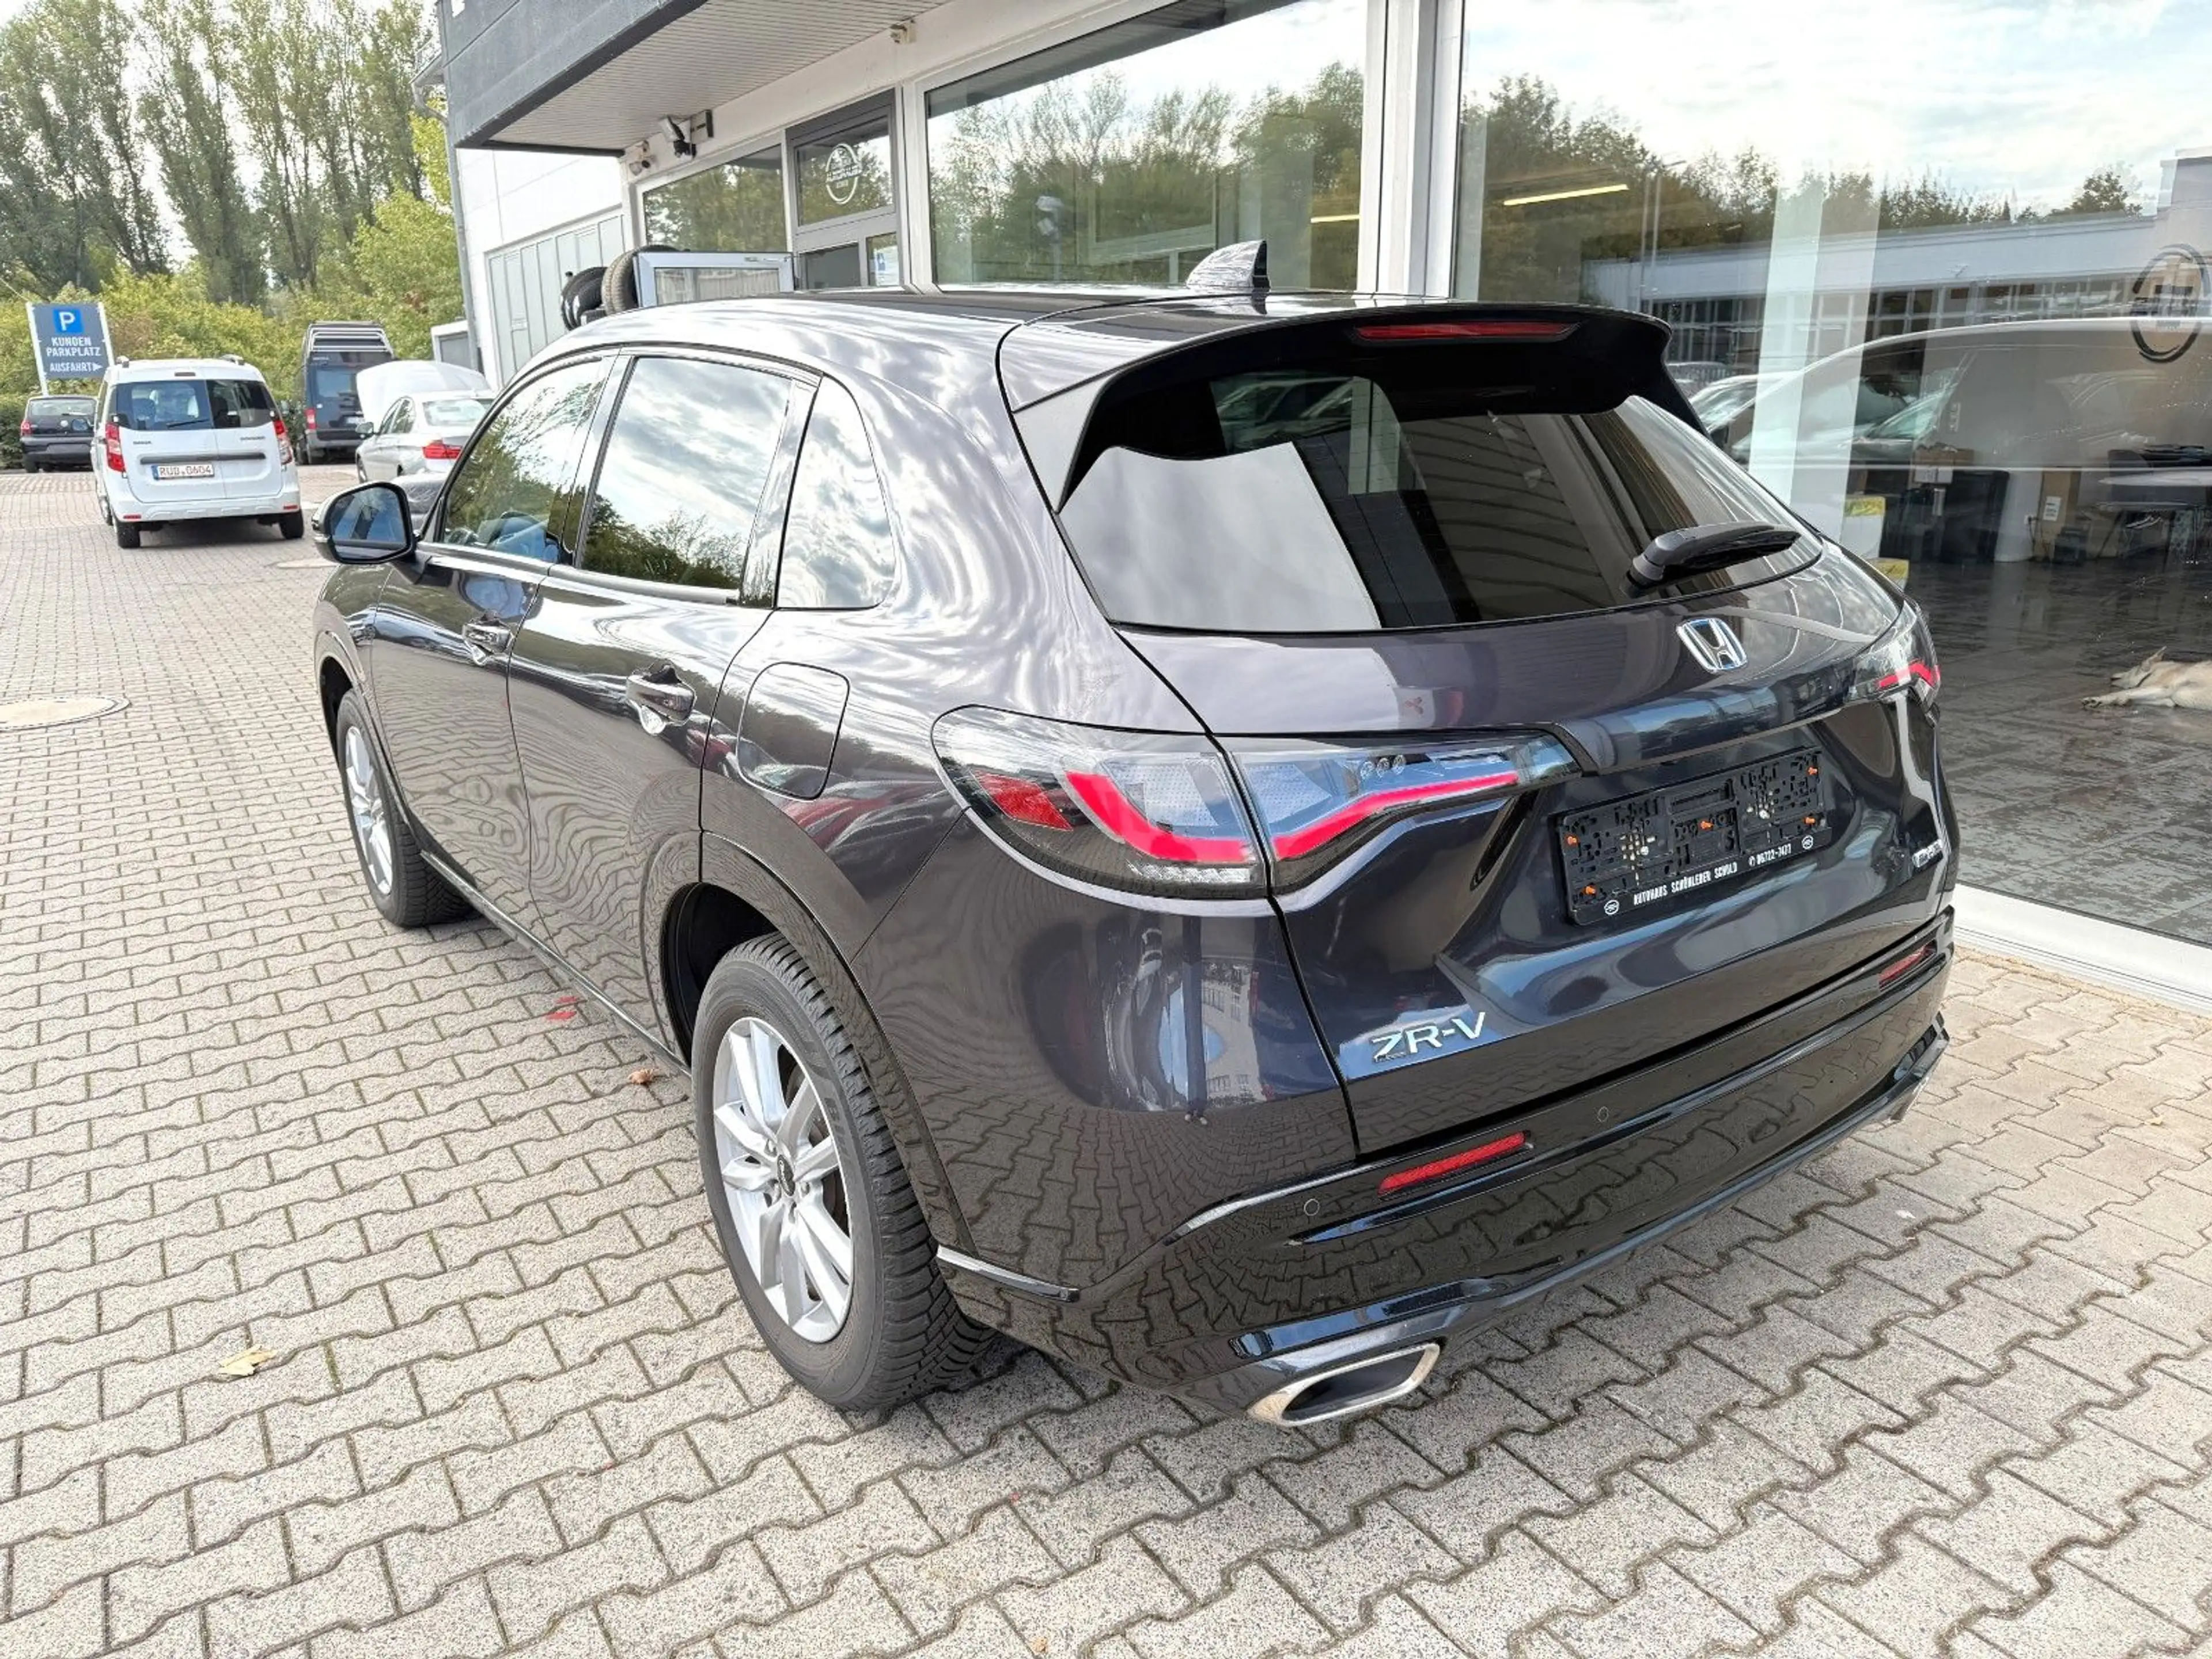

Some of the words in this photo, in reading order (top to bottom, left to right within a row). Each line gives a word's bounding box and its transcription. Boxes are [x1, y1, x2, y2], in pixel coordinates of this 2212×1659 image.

[59, 311, 75, 331] P
[51, 336, 92, 347] KUNDEN
[46, 346, 102, 357] PARKPLATZ
[50, 362, 92, 372] AUSFAHRT
[1634, 884, 1668, 906] AUTOHAUS
[1371, 1012, 1486, 1062] ZR-V
